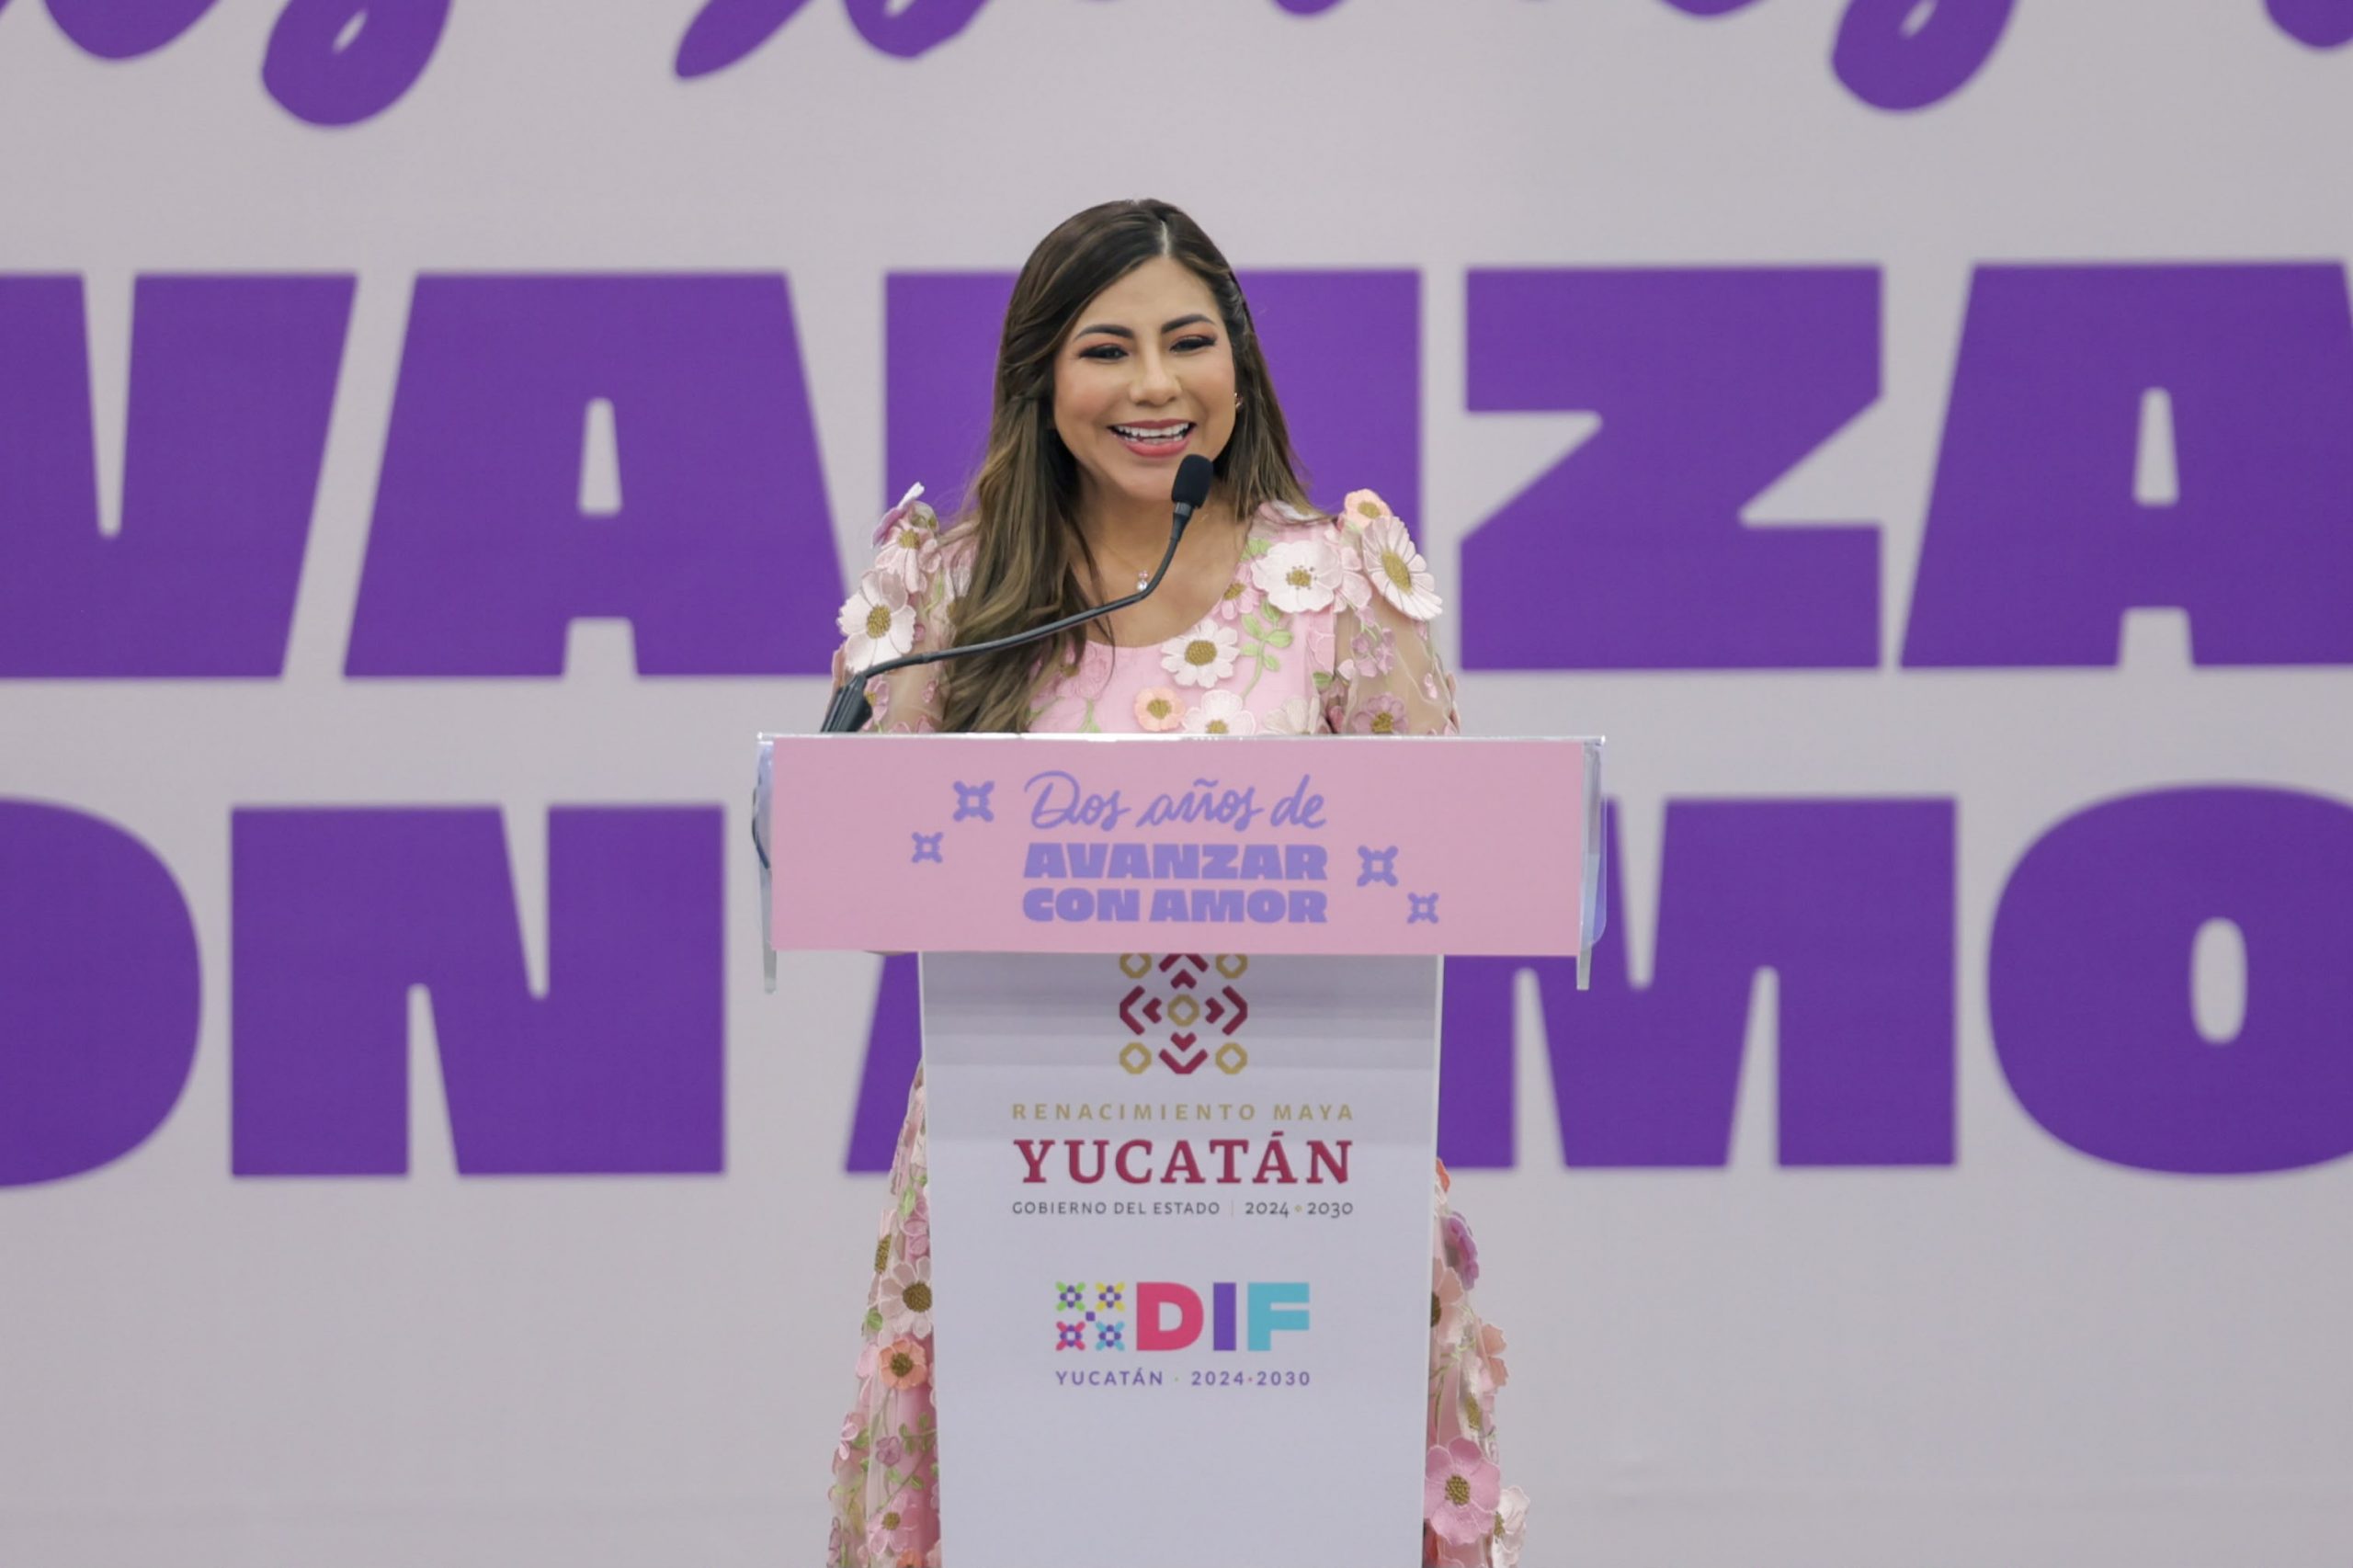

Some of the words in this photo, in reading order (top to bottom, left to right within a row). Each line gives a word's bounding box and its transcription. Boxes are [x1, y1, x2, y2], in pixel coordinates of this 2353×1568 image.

[1023, 769, 1131, 833] Dos
[1135, 778, 1266, 833] años
[1269, 773, 1327, 830] de
[1022, 842, 1329, 881] AVANZAR
[1022, 887, 1141, 923] CON
[1148, 889, 1329, 925] AMOR
[1012, 1103, 1256, 1121] RENACIMIENTO
[1273, 1104, 1354, 1121] MAYA
[1013, 1131, 1354, 1185] YUCATÁN
[1012, 1200, 1108, 1215] GOBIERNO
[1113, 1201, 1147, 1215] DEL
[1153, 1201, 1221, 1215] ESTADO
[1135, 1281, 1310, 1352] DIF
[1055, 1367, 1164, 1386] YUCATÁN
